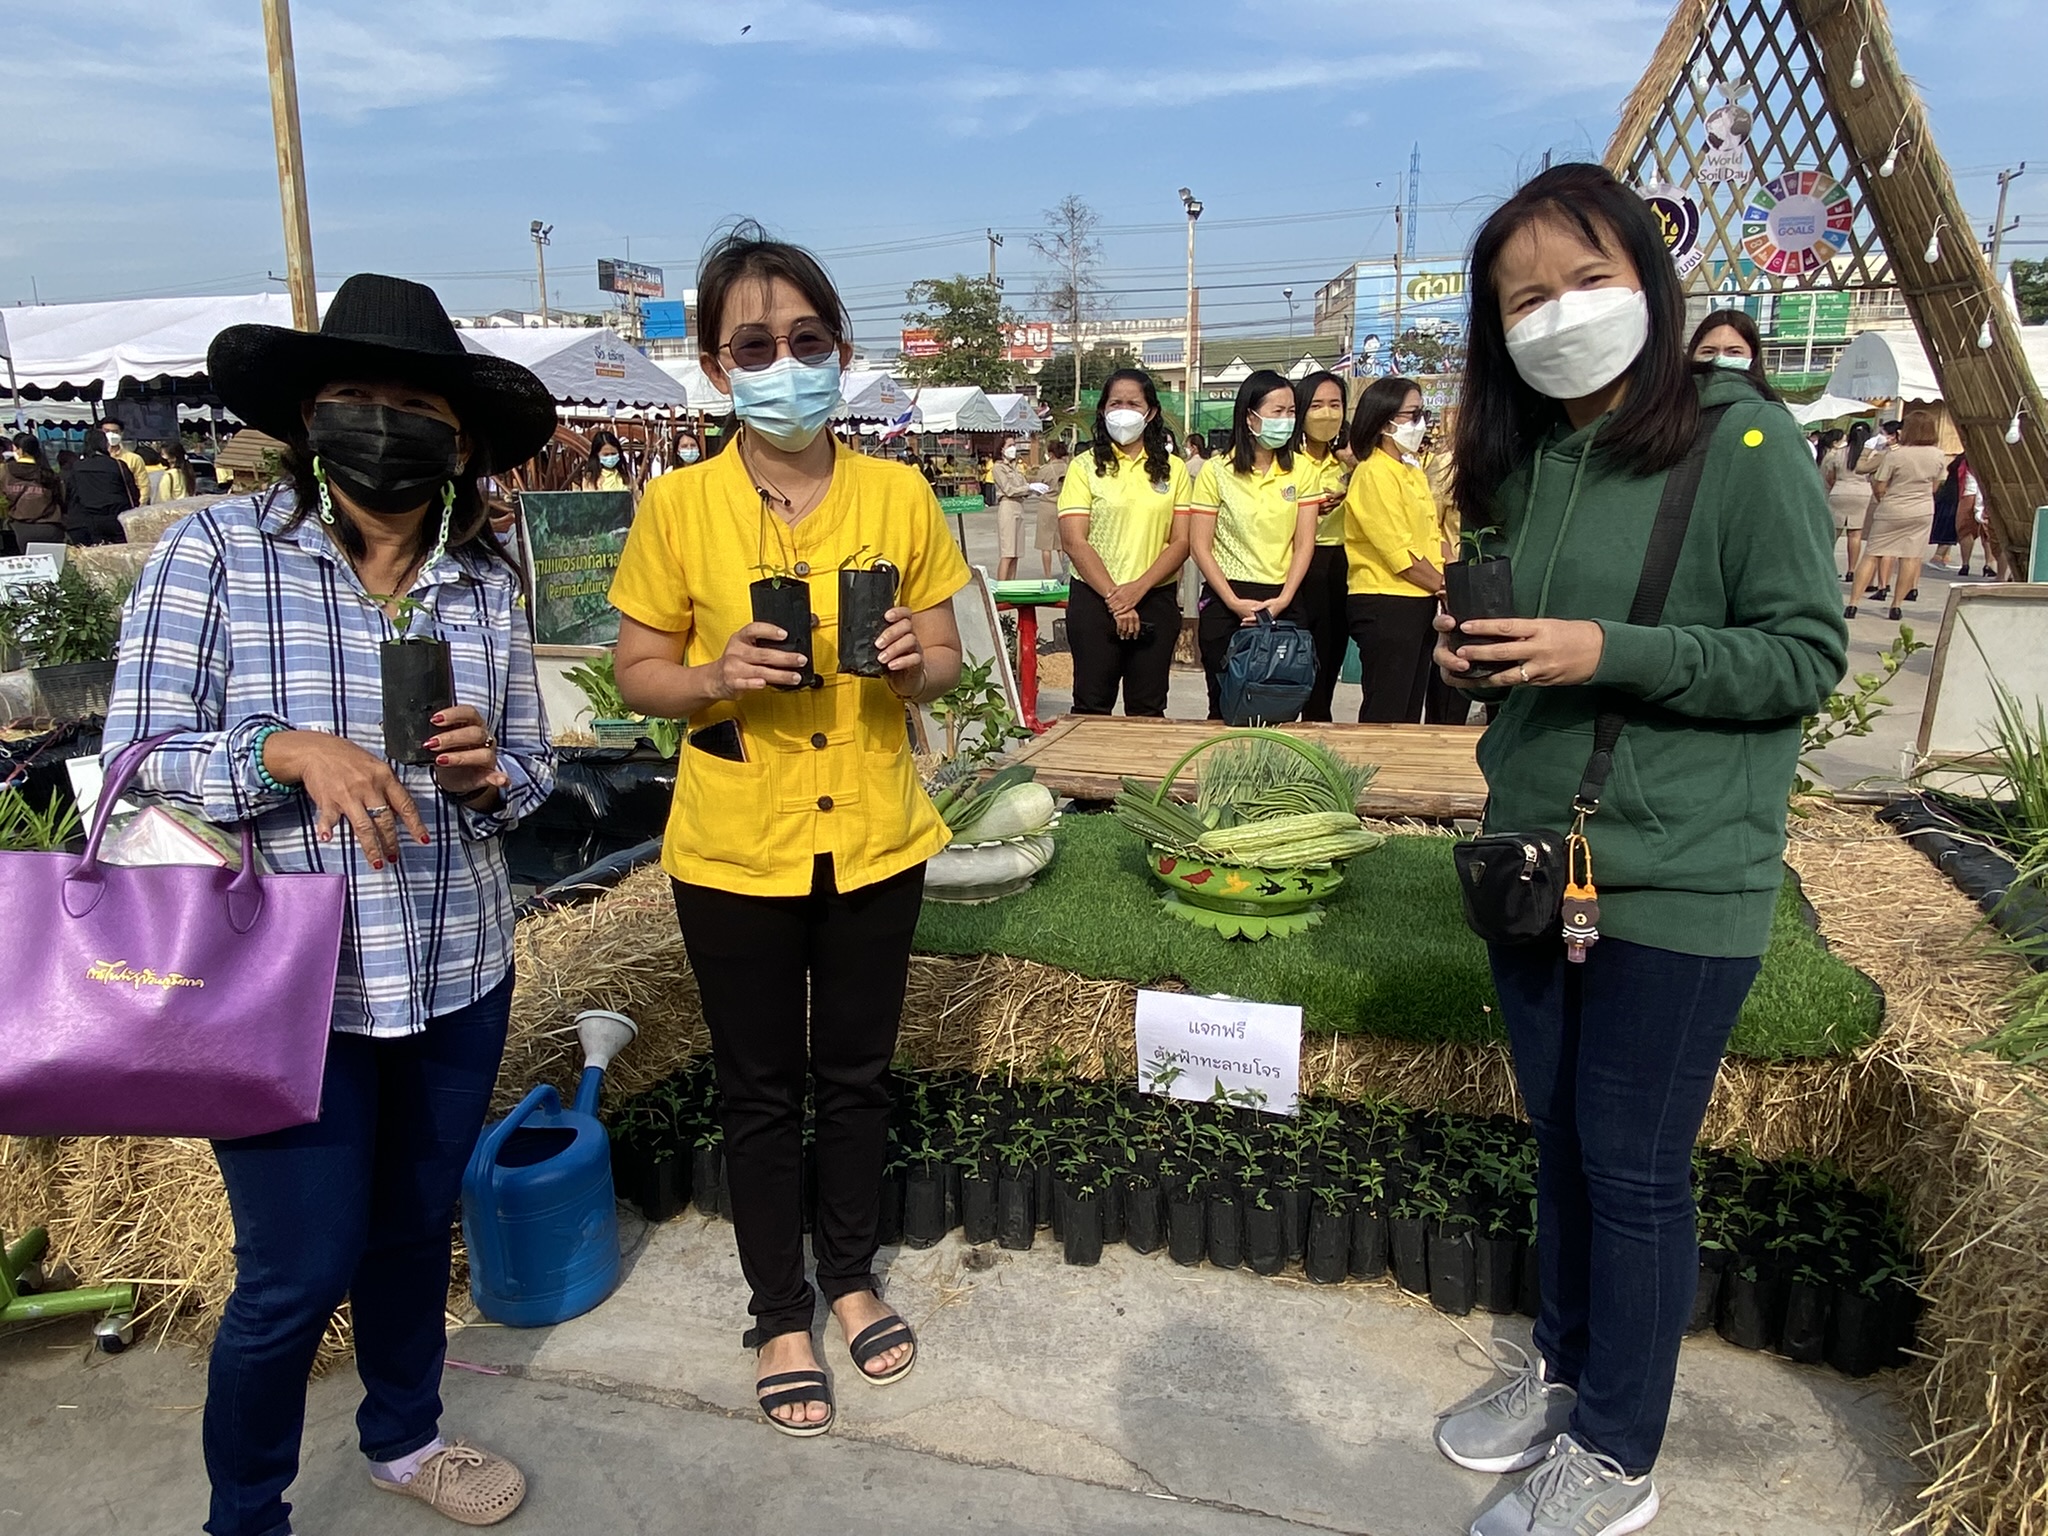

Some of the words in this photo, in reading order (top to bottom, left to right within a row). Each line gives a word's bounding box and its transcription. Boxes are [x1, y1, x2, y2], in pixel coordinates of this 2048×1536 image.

[1707, 152, 1743, 166] World
[1699, 168, 1721, 181] Soil
[1725, 168, 1748, 182] Day
[1778, 225, 1815, 236] GOALS
[546, 574, 610, 603] (Permaculture)
[1188, 1020, 1247, 1039] แจกฟรี
[1153, 1045, 1281, 1078] ต้นฟ้าทะลายโจร
